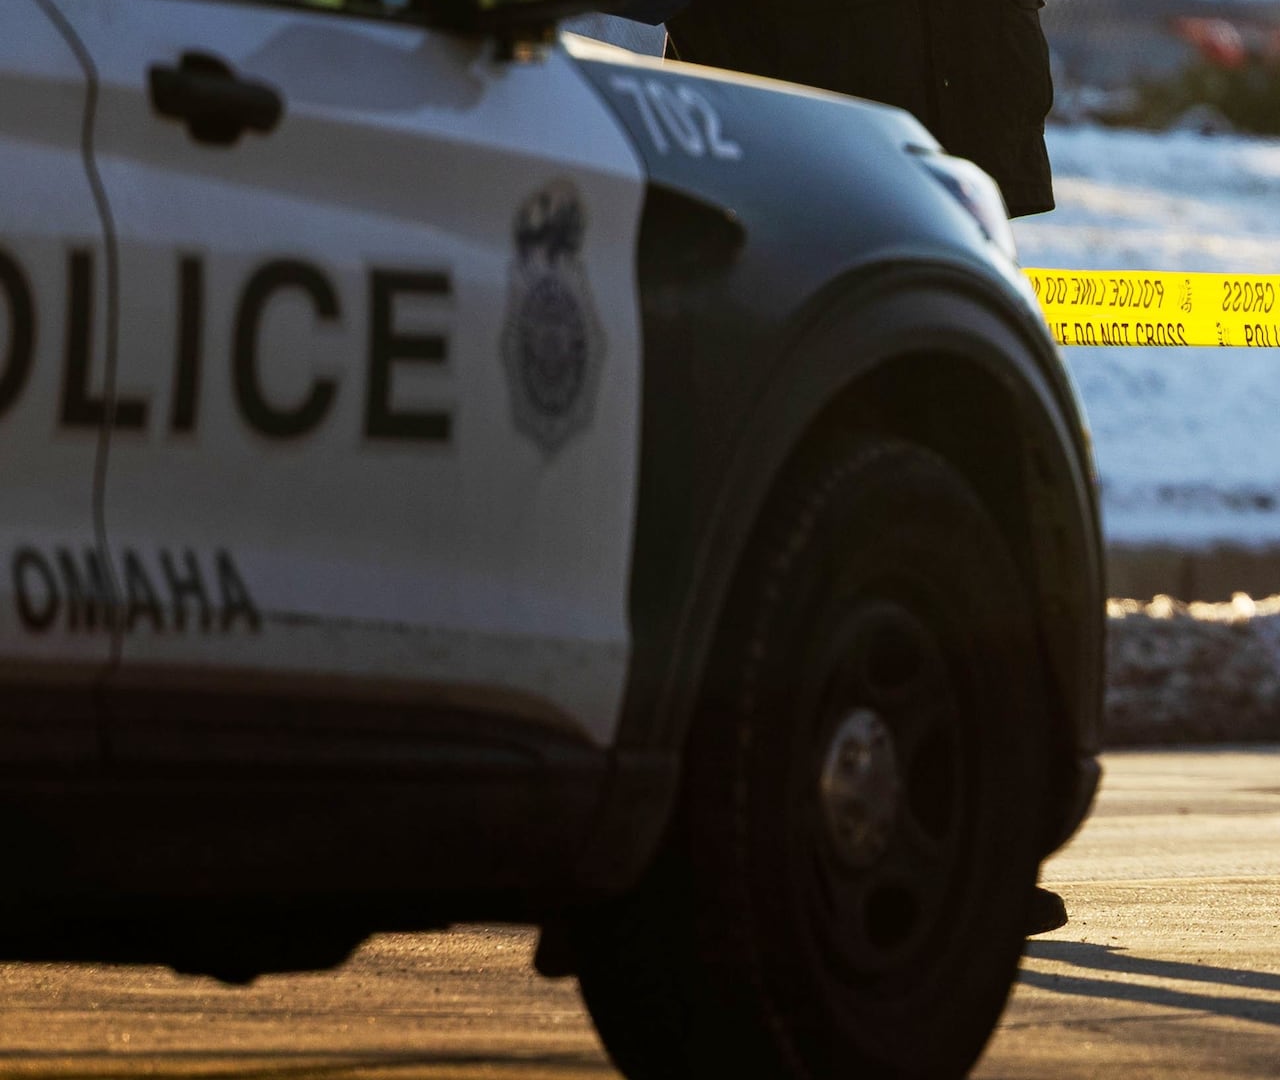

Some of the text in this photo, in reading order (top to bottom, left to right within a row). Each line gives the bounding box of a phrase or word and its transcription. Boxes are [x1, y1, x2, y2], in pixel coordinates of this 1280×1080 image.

[1100, 322, 1131, 346] NOT
[1135, 322, 1189, 346] CROSS
[12, 545, 260, 636] OMAHA
